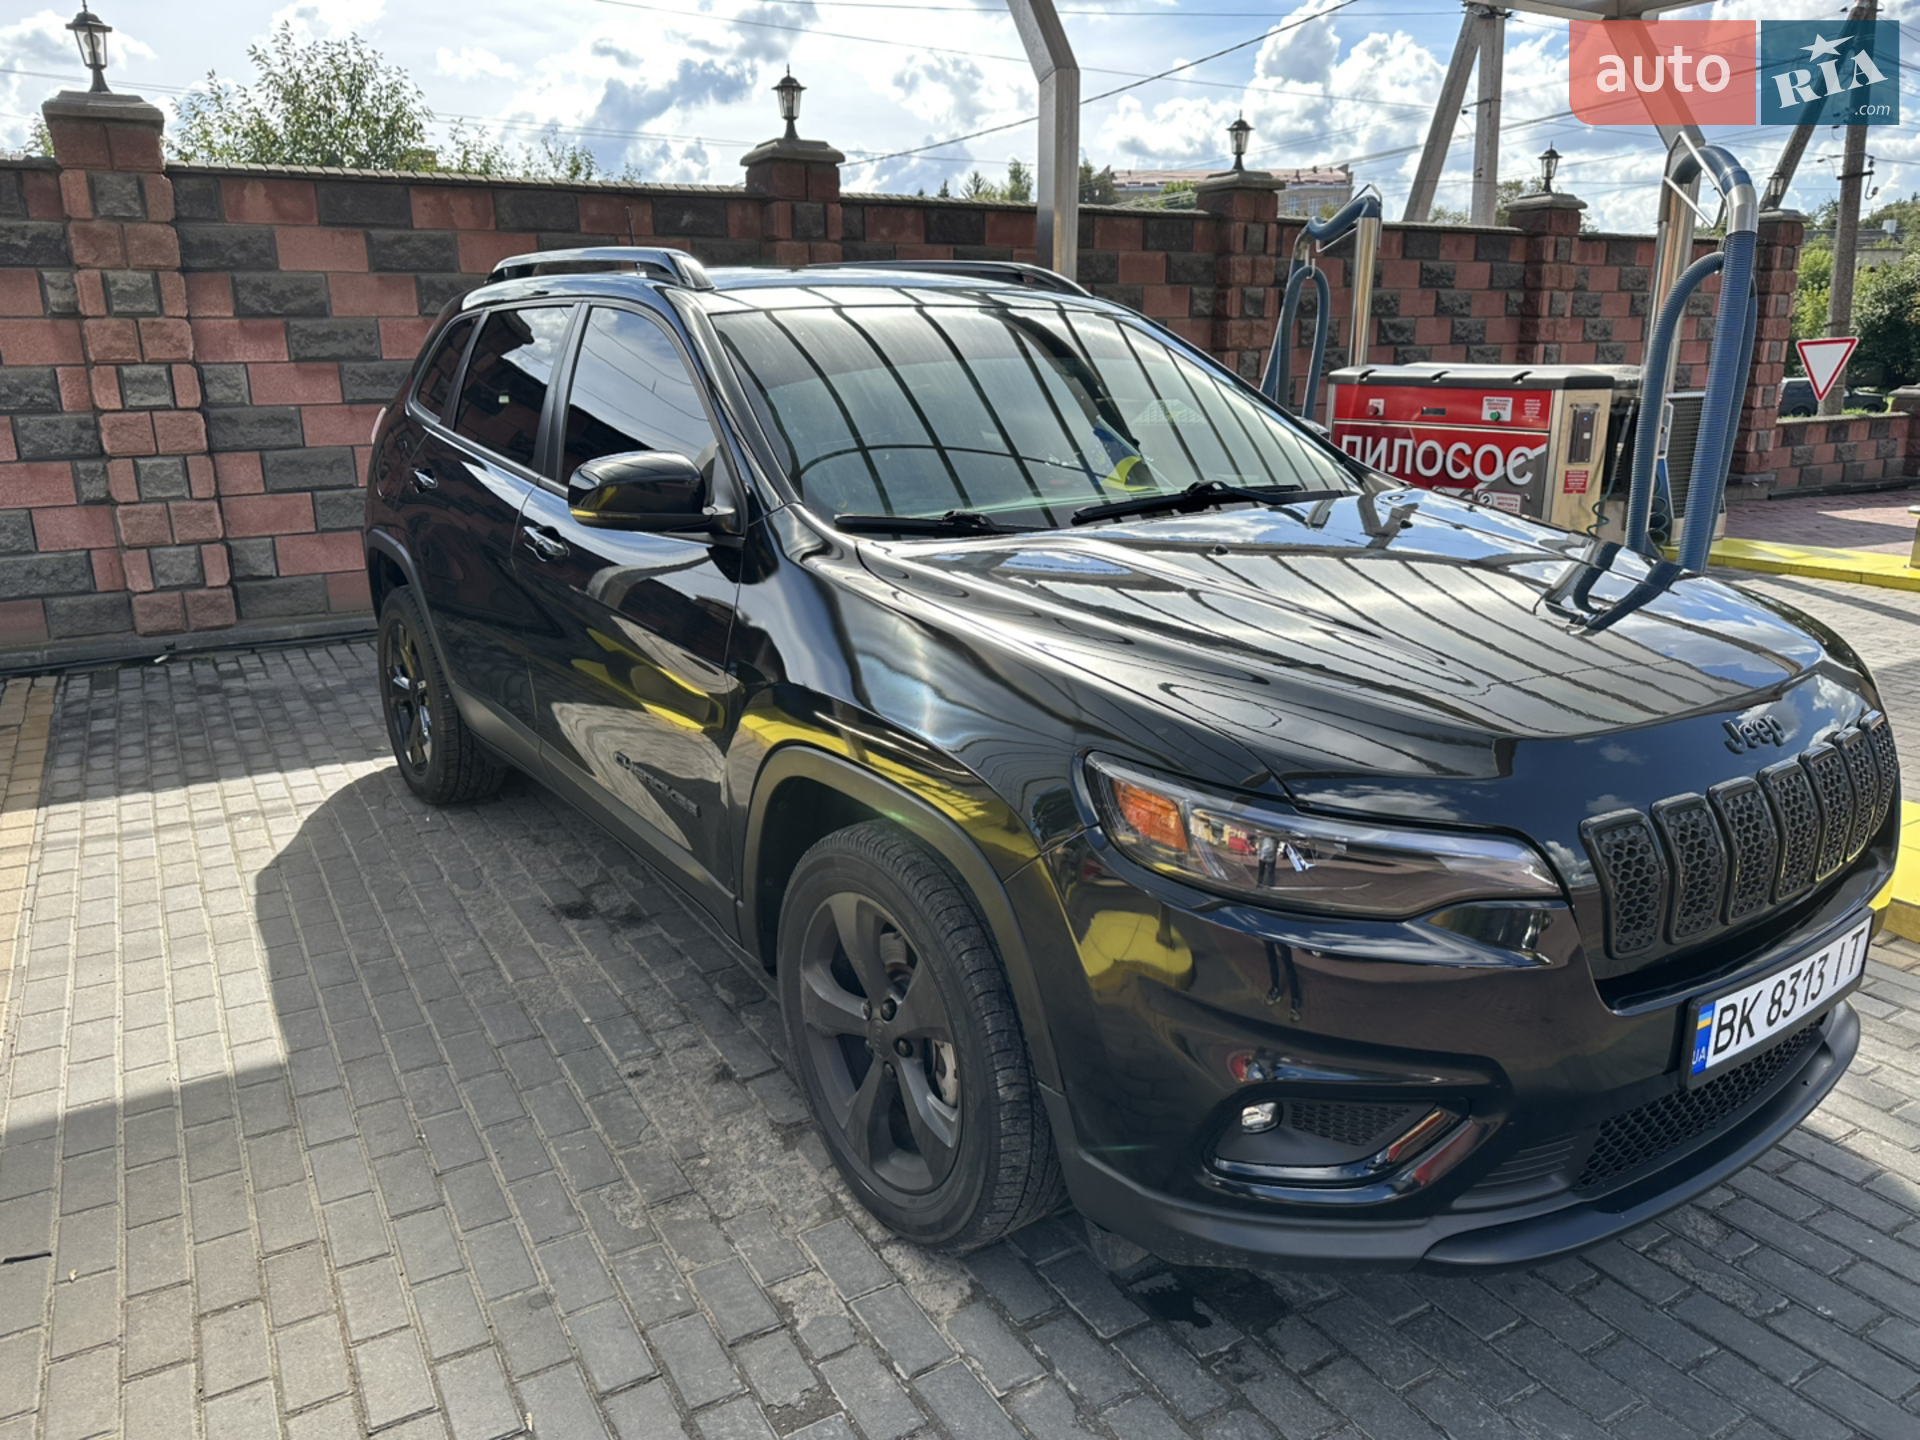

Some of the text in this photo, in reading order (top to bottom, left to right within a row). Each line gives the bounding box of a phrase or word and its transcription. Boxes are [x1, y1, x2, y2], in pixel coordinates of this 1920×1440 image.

[1341, 434, 1535, 486] ПИЛОСОС
[1721, 714, 1786, 755] Jeep
[1713, 927, 1866, 1056] BK 8313 IT
[1692, 1046, 1706, 1065] UA
